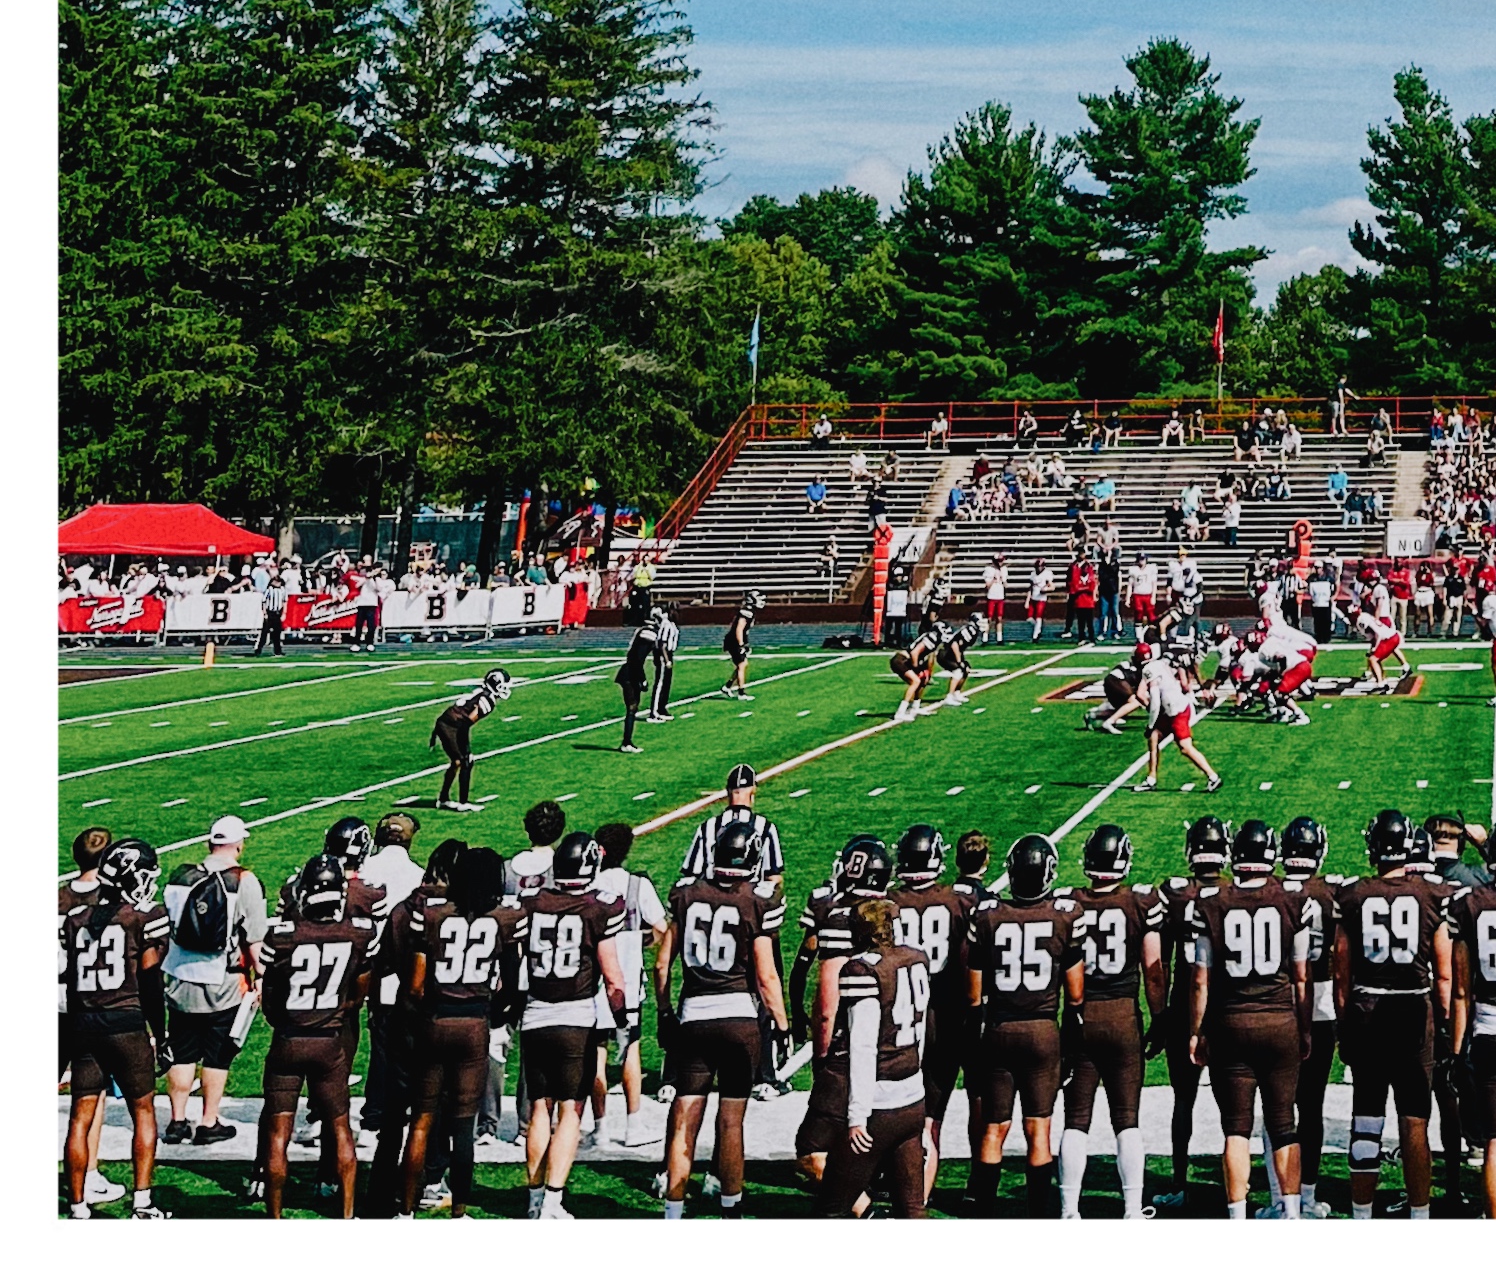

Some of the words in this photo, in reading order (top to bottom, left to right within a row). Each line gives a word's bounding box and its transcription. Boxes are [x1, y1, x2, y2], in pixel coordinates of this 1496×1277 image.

[210, 599, 229, 623] B
[427, 596, 446, 620] B
[522, 592, 535, 616] B
[76, 924, 126, 991] 23
[435, 916, 499, 984] 32
[530, 912, 584, 979] 58
[684, 901, 741, 972] 66
[994, 920, 1055, 993] 35
[1224, 906, 1282, 978] 90
[1361, 896, 1420, 964] 69
[286, 941, 353, 1010] 27
[892, 962, 930, 1047] 49
